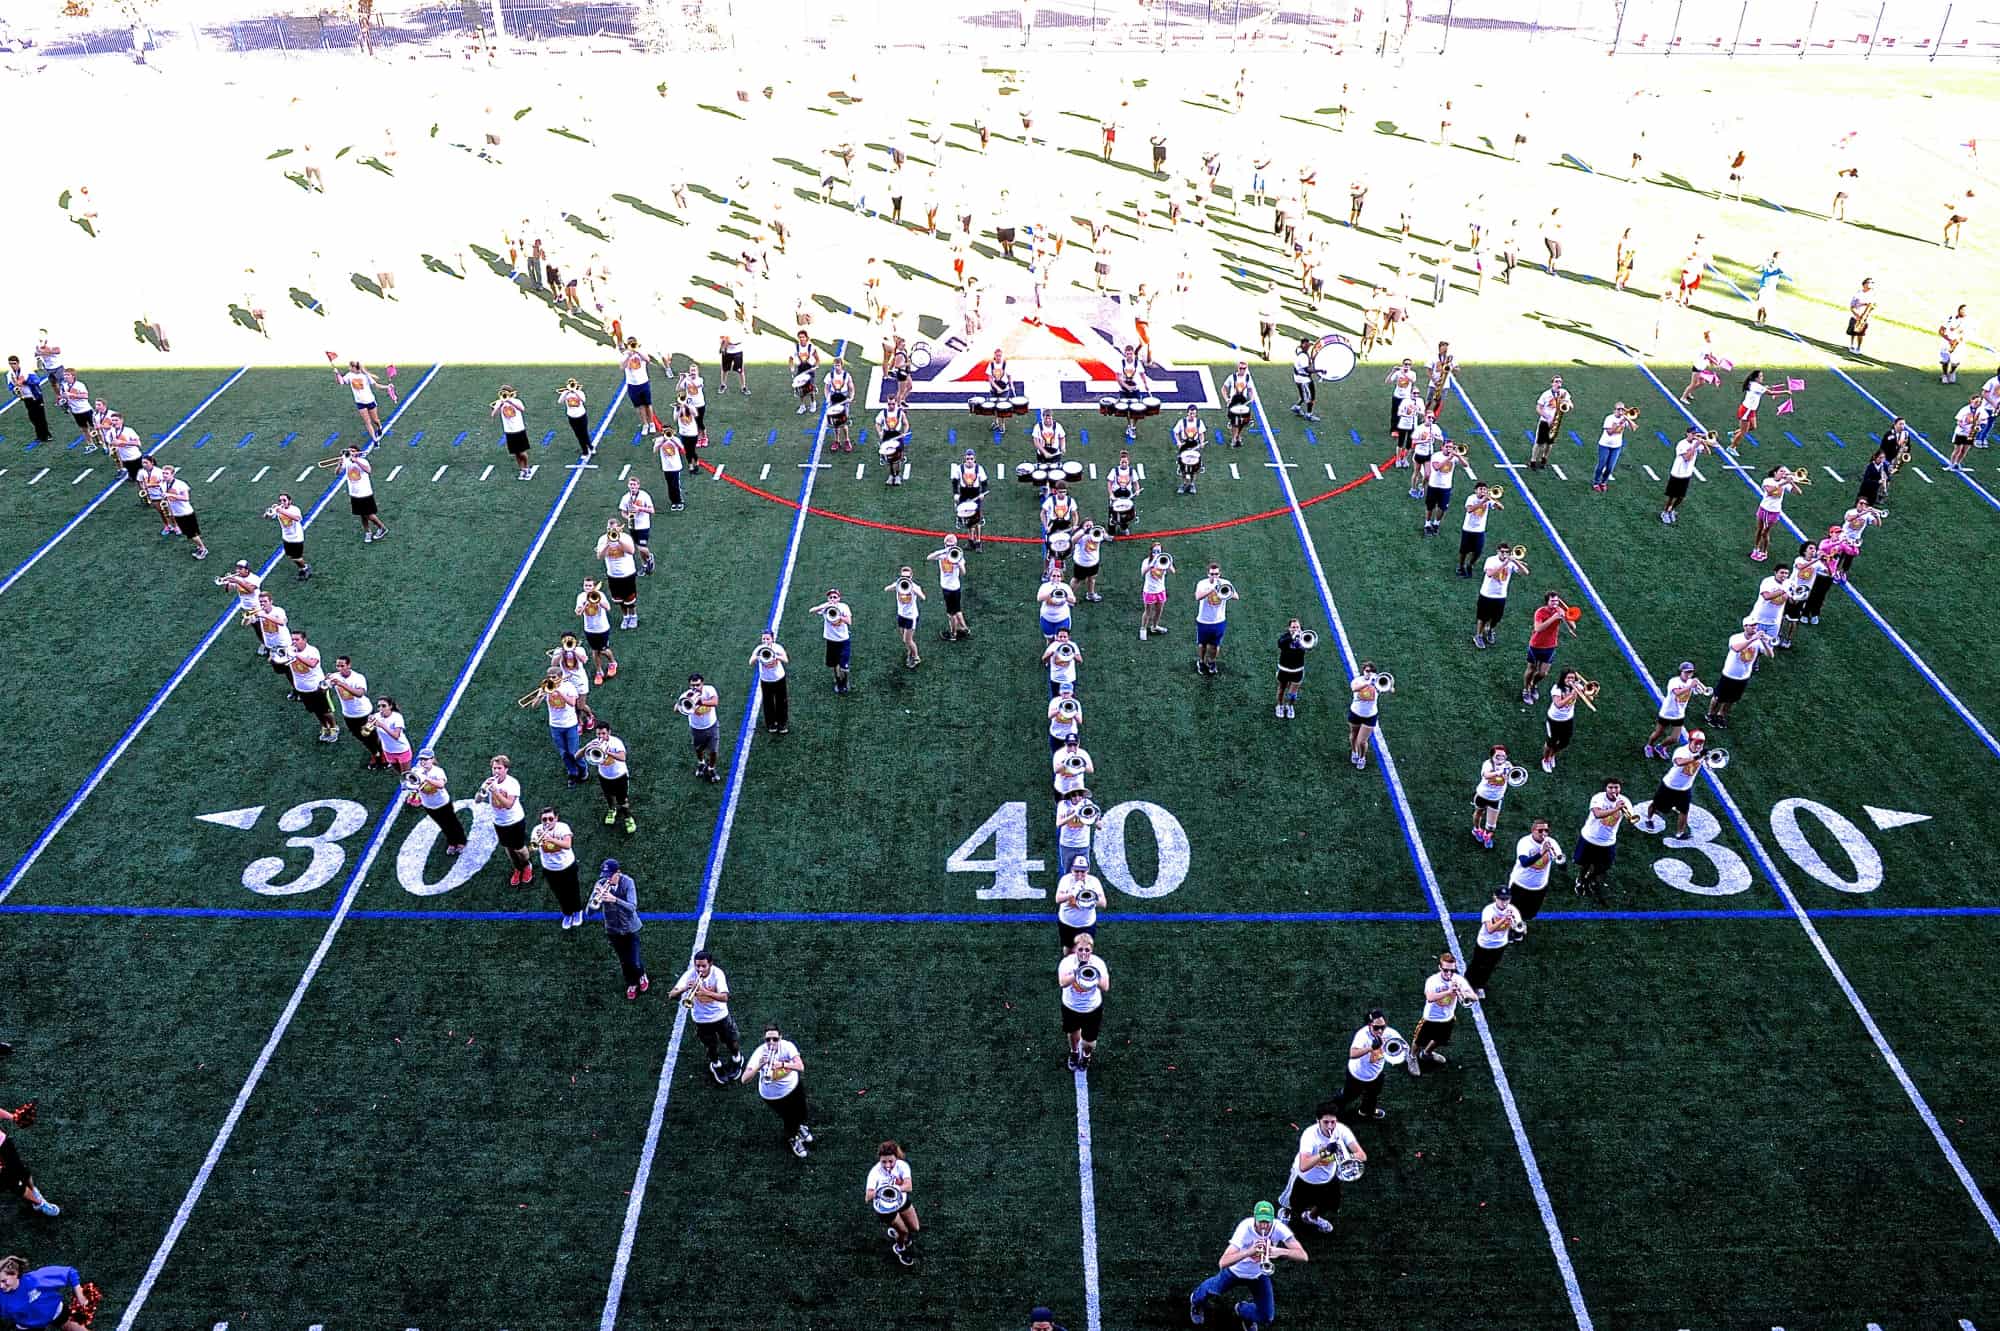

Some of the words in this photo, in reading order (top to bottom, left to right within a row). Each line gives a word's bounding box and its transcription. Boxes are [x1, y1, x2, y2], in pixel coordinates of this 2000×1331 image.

[241, 799, 500, 896] 30
[946, 800, 1190, 899] 40
[1631, 798, 1884, 896] 30
